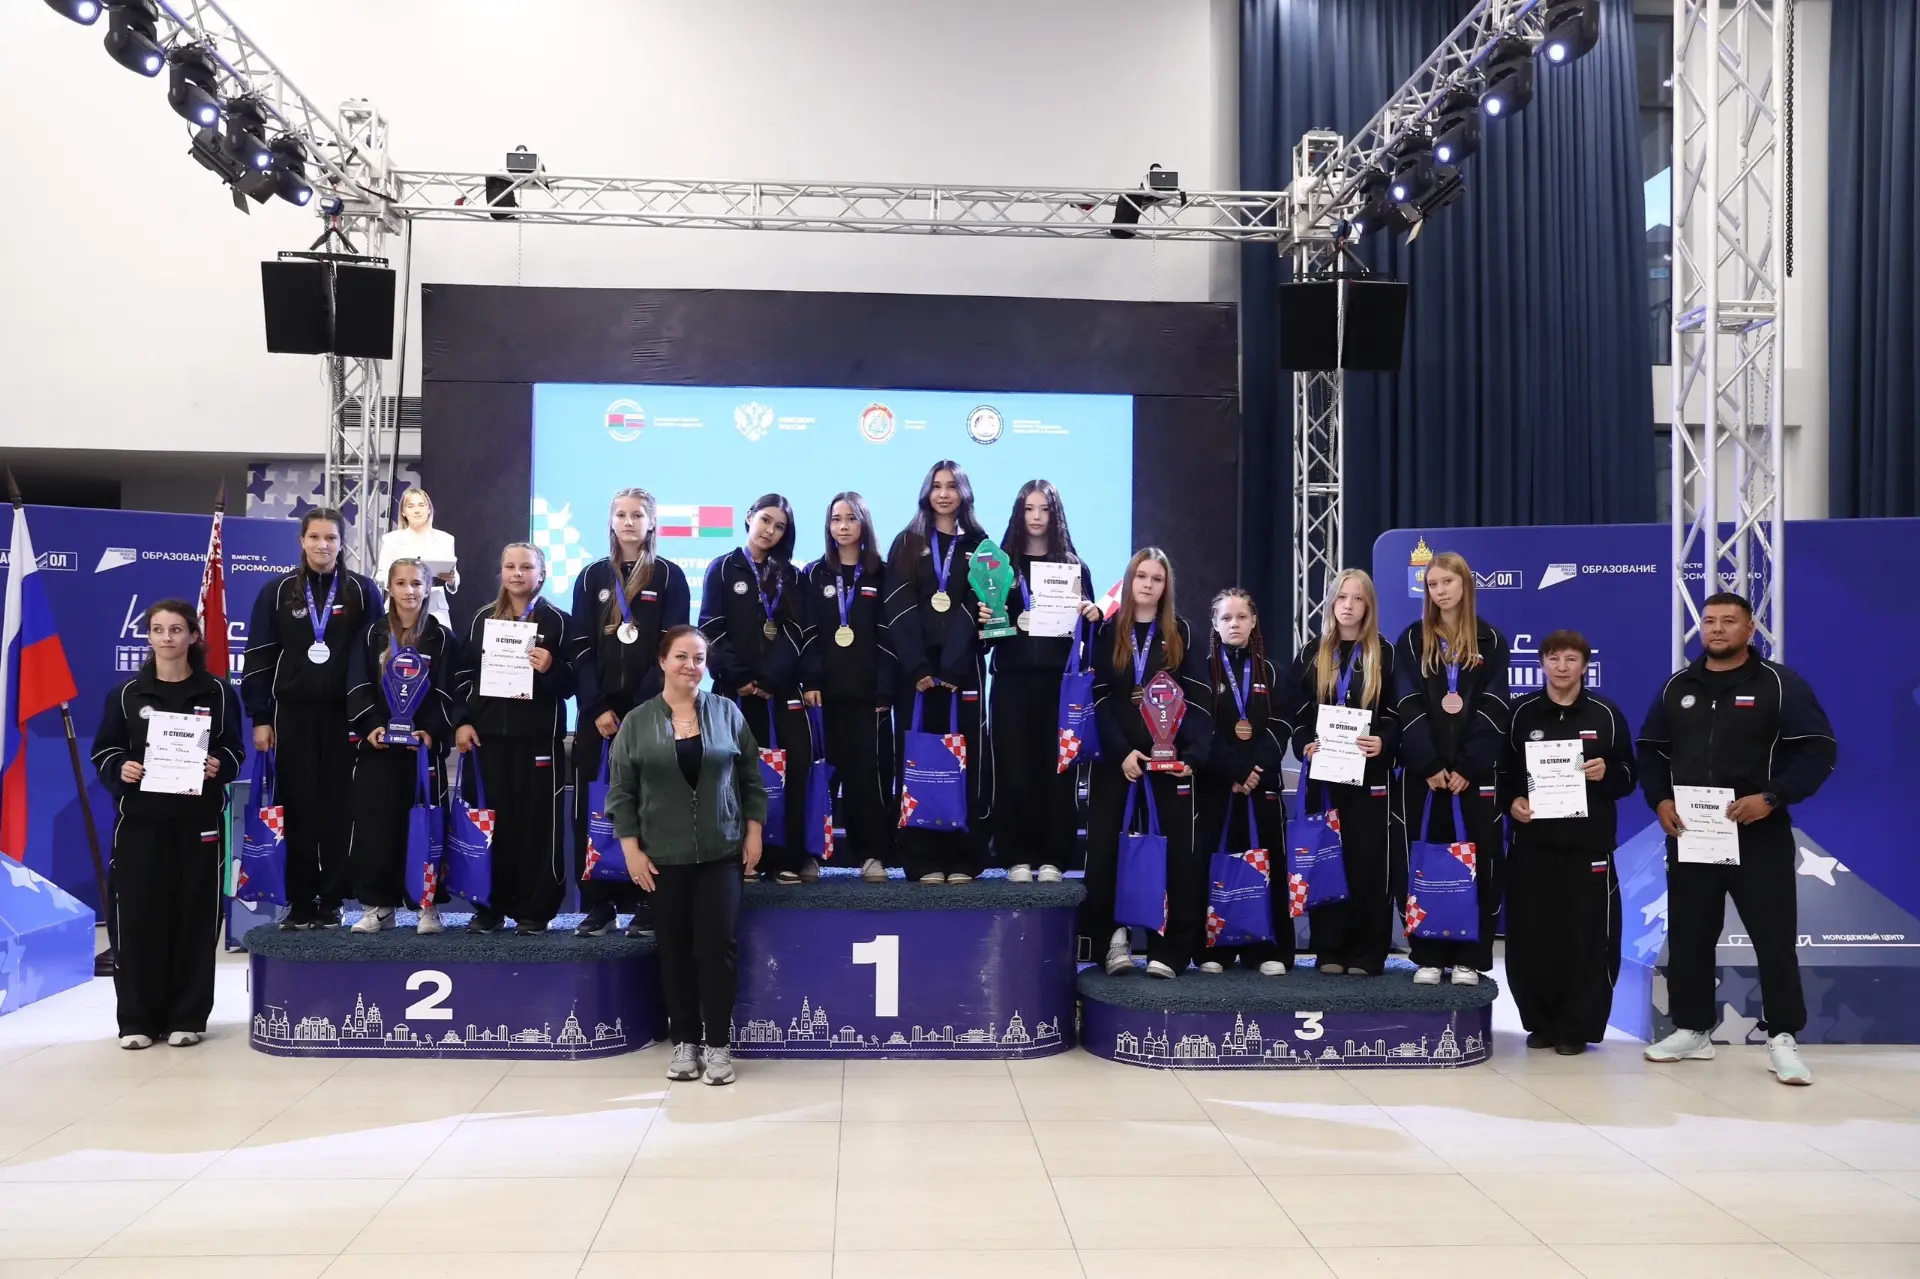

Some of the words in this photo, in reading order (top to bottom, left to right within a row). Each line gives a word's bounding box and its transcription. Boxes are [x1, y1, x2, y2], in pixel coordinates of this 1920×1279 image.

[1581, 564, 1657, 574] ОБРАЗОВАНИЕ
[988, 578, 994, 587] 1
[401, 683, 408, 693] 2
[1160, 710, 1167, 719] 3
[1335, 723, 1358, 731] СТЕПЕНИ
[1821, 932, 1881, 942] МОЛОДЕЖНЫЙ
[1881, 934, 1905, 942] ЦЕНТР
[852, 934, 900, 1017] 1
[405, 969, 453, 1020] 2
[1294, 1010, 1325, 1040] 3
